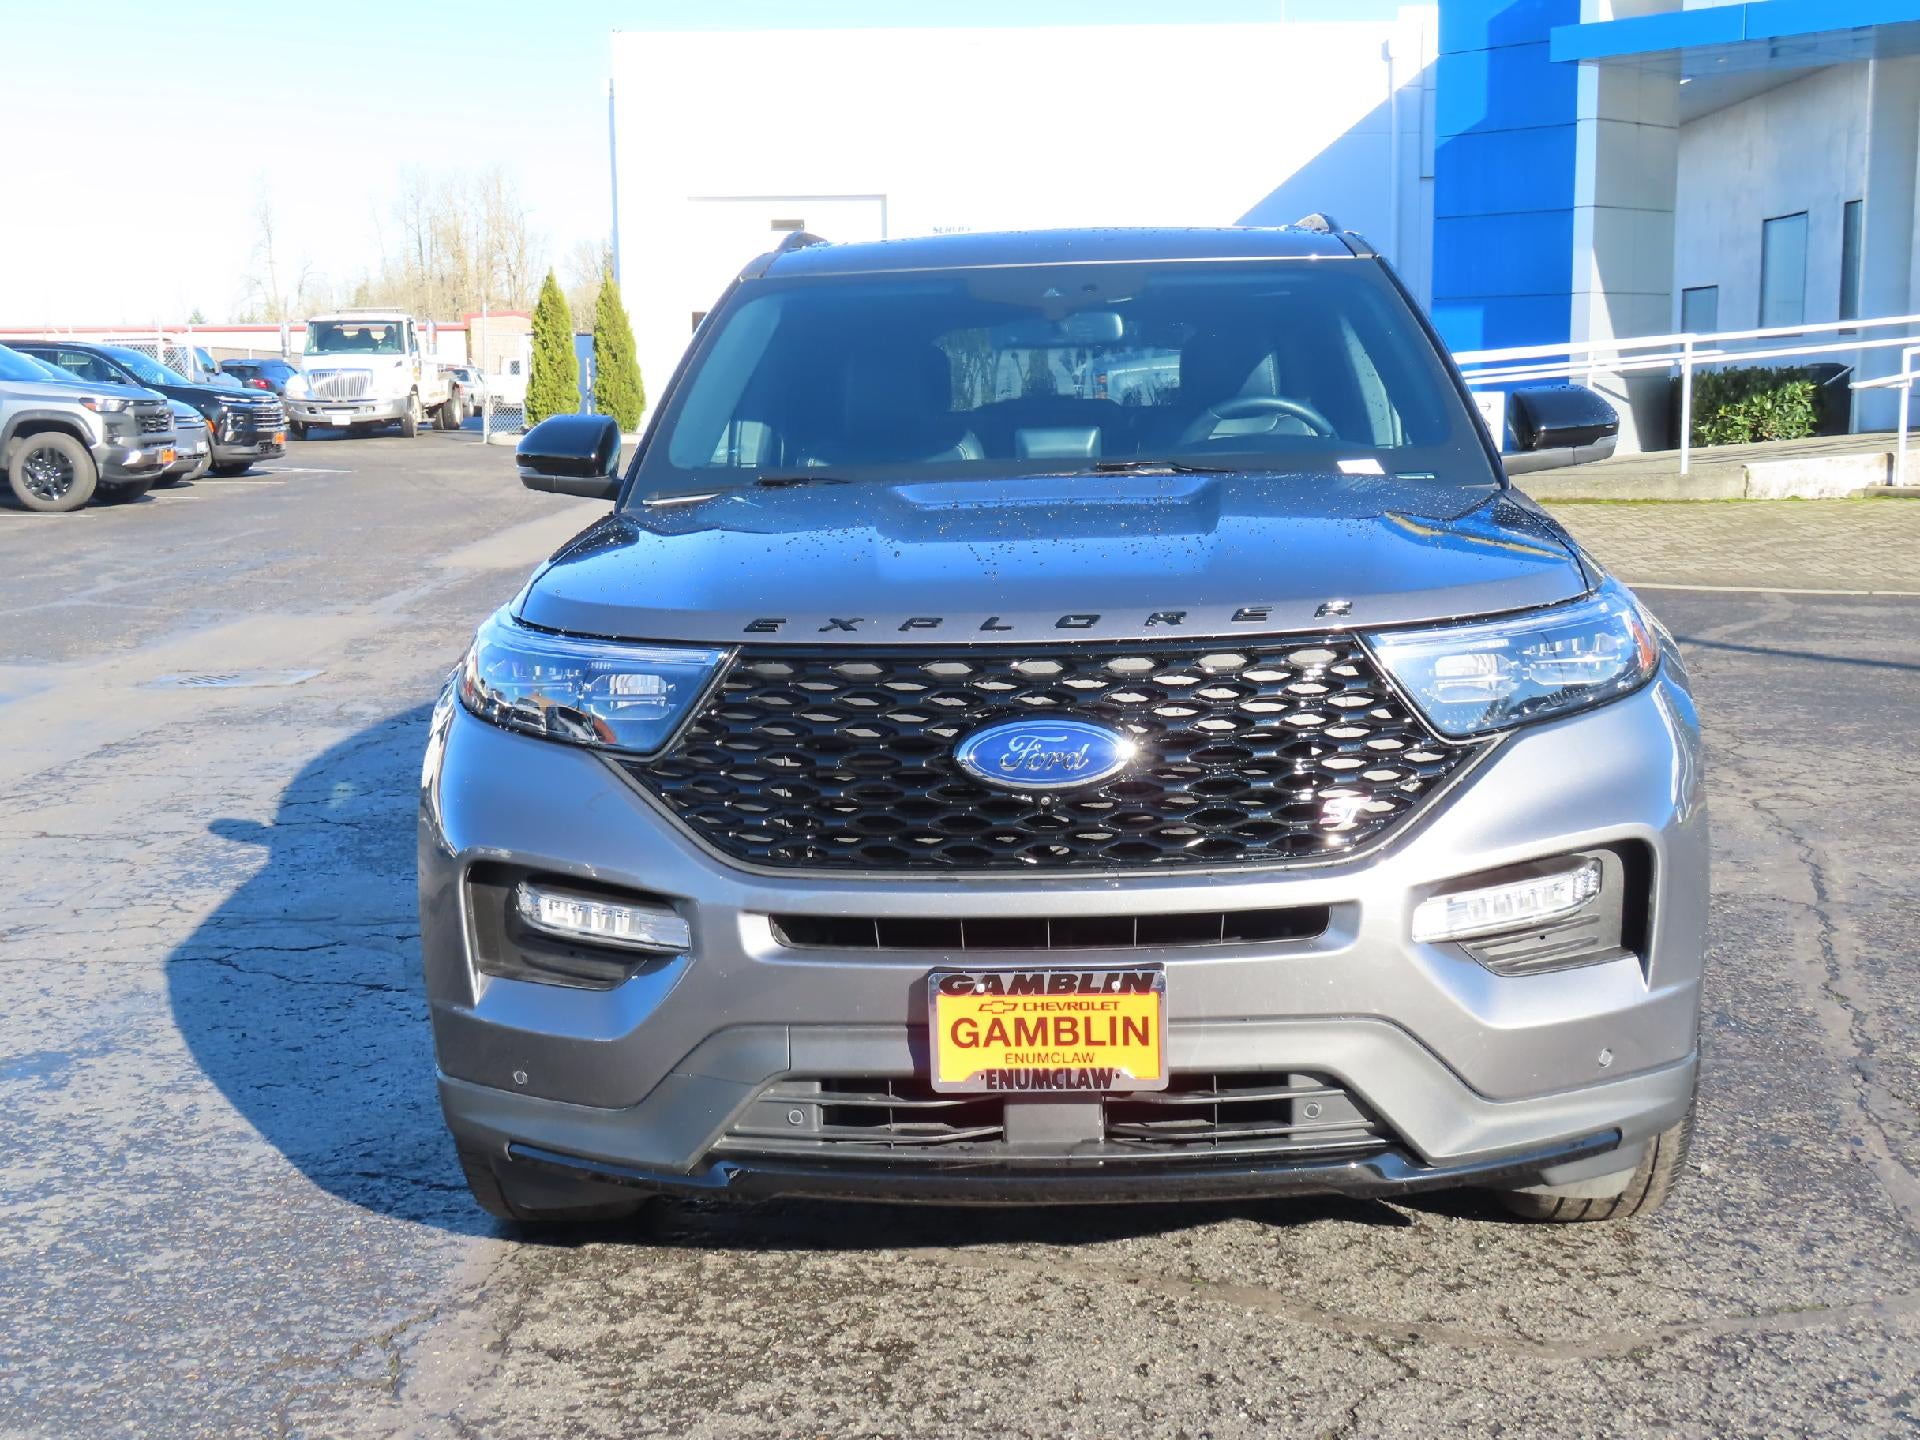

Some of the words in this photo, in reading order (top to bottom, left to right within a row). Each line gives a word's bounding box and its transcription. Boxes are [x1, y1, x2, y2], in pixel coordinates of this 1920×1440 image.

[743, 601, 1353, 632] EXPLORER
[1000, 735, 1090, 771] Ford
[939, 973, 1154, 996] GAMBLIN
[1023, 1001, 1120, 1012] CHEVROLET
[951, 1016, 1149, 1048] GAMBLIN
[1005, 1052, 1095, 1065] ENUMCLAW
[986, 1068, 1113, 1090] ENUMCLAW
